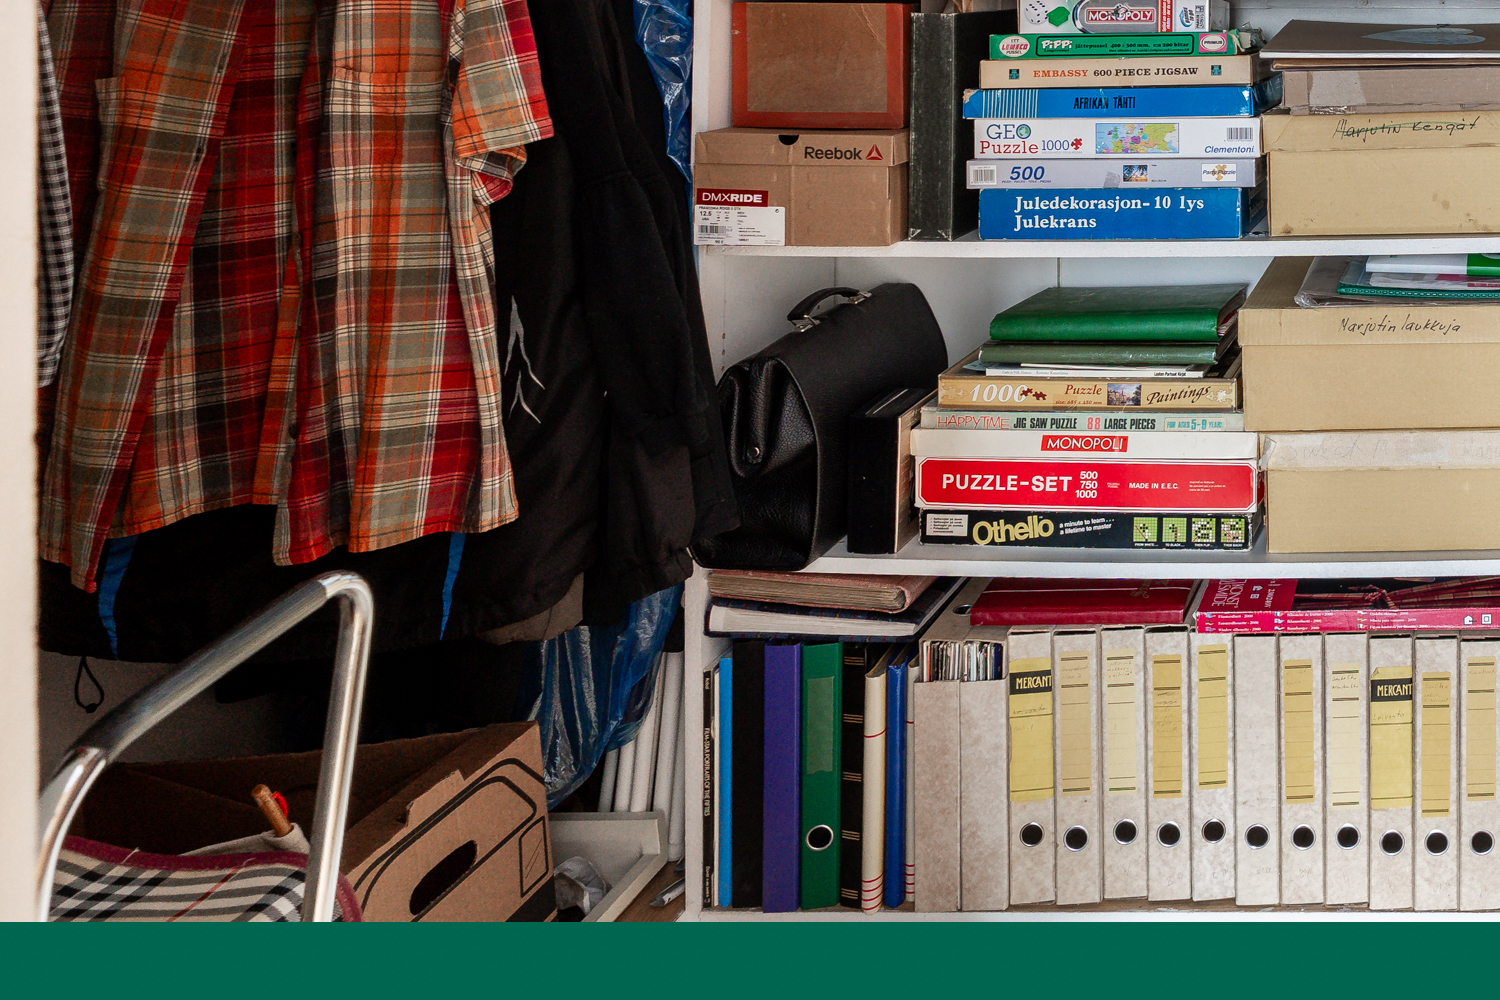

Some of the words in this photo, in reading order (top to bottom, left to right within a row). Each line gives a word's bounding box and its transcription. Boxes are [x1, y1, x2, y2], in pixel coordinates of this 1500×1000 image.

[1033, 69, 1089, 78] EMBASSY
[1093, 69, 1112, 77] 600
[1115, 68, 1151, 77] PIECE
[1154, 67, 1199, 76] JIGSAW
[1073, 96, 1109, 110] AFRIKAN
[1113, 95, 1136, 109] TÄHTI
[986, 123, 1032, 140] GEO
[979, 140, 1039, 154] Puzzle
[1041, 139, 1070, 151] 1000
[1204, 145, 1255, 154] Clementoni
[804, 146, 863, 160] Reebok
[1010, 165, 1046, 181] 500
[702, 192, 763, 208] DMXRIDE
[1154, 195, 1171, 209] 10
[1179, 195, 1205, 213] lys
[1014, 214, 1097, 232] Julekrans
[1401, 313, 1462, 334] laukkuja
[969, 383, 1030, 403] 1000
[1064, 384, 1102, 396] Puzzle
[1146, 385, 1212, 405] Paintings
[937, 414, 1011, 430] HAPPYTIME
[1013, 417, 1027, 429] JIG
[1029, 417, 1048, 429] SAW
[1050, 417, 1078, 430] PUZZLE
[1087, 417, 1101, 430] 88
[1104, 418, 1128, 430] LARGE
[1130, 418, 1156, 430] PIECES
[1191, 419, 1207, 430] 5-9
[1046, 436, 1124, 450] MONOPOLI
[1080, 471, 1098, 480] 500
[942, 473, 1073, 493] PUZZLE-SET
[1080, 480, 1098, 489] 750
[1075, 489, 1097, 499] 1000
[972, 515, 1055, 545] Othello
[1064, 519, 1083, 528] minute
[1093, 523, 1112, 531] master
